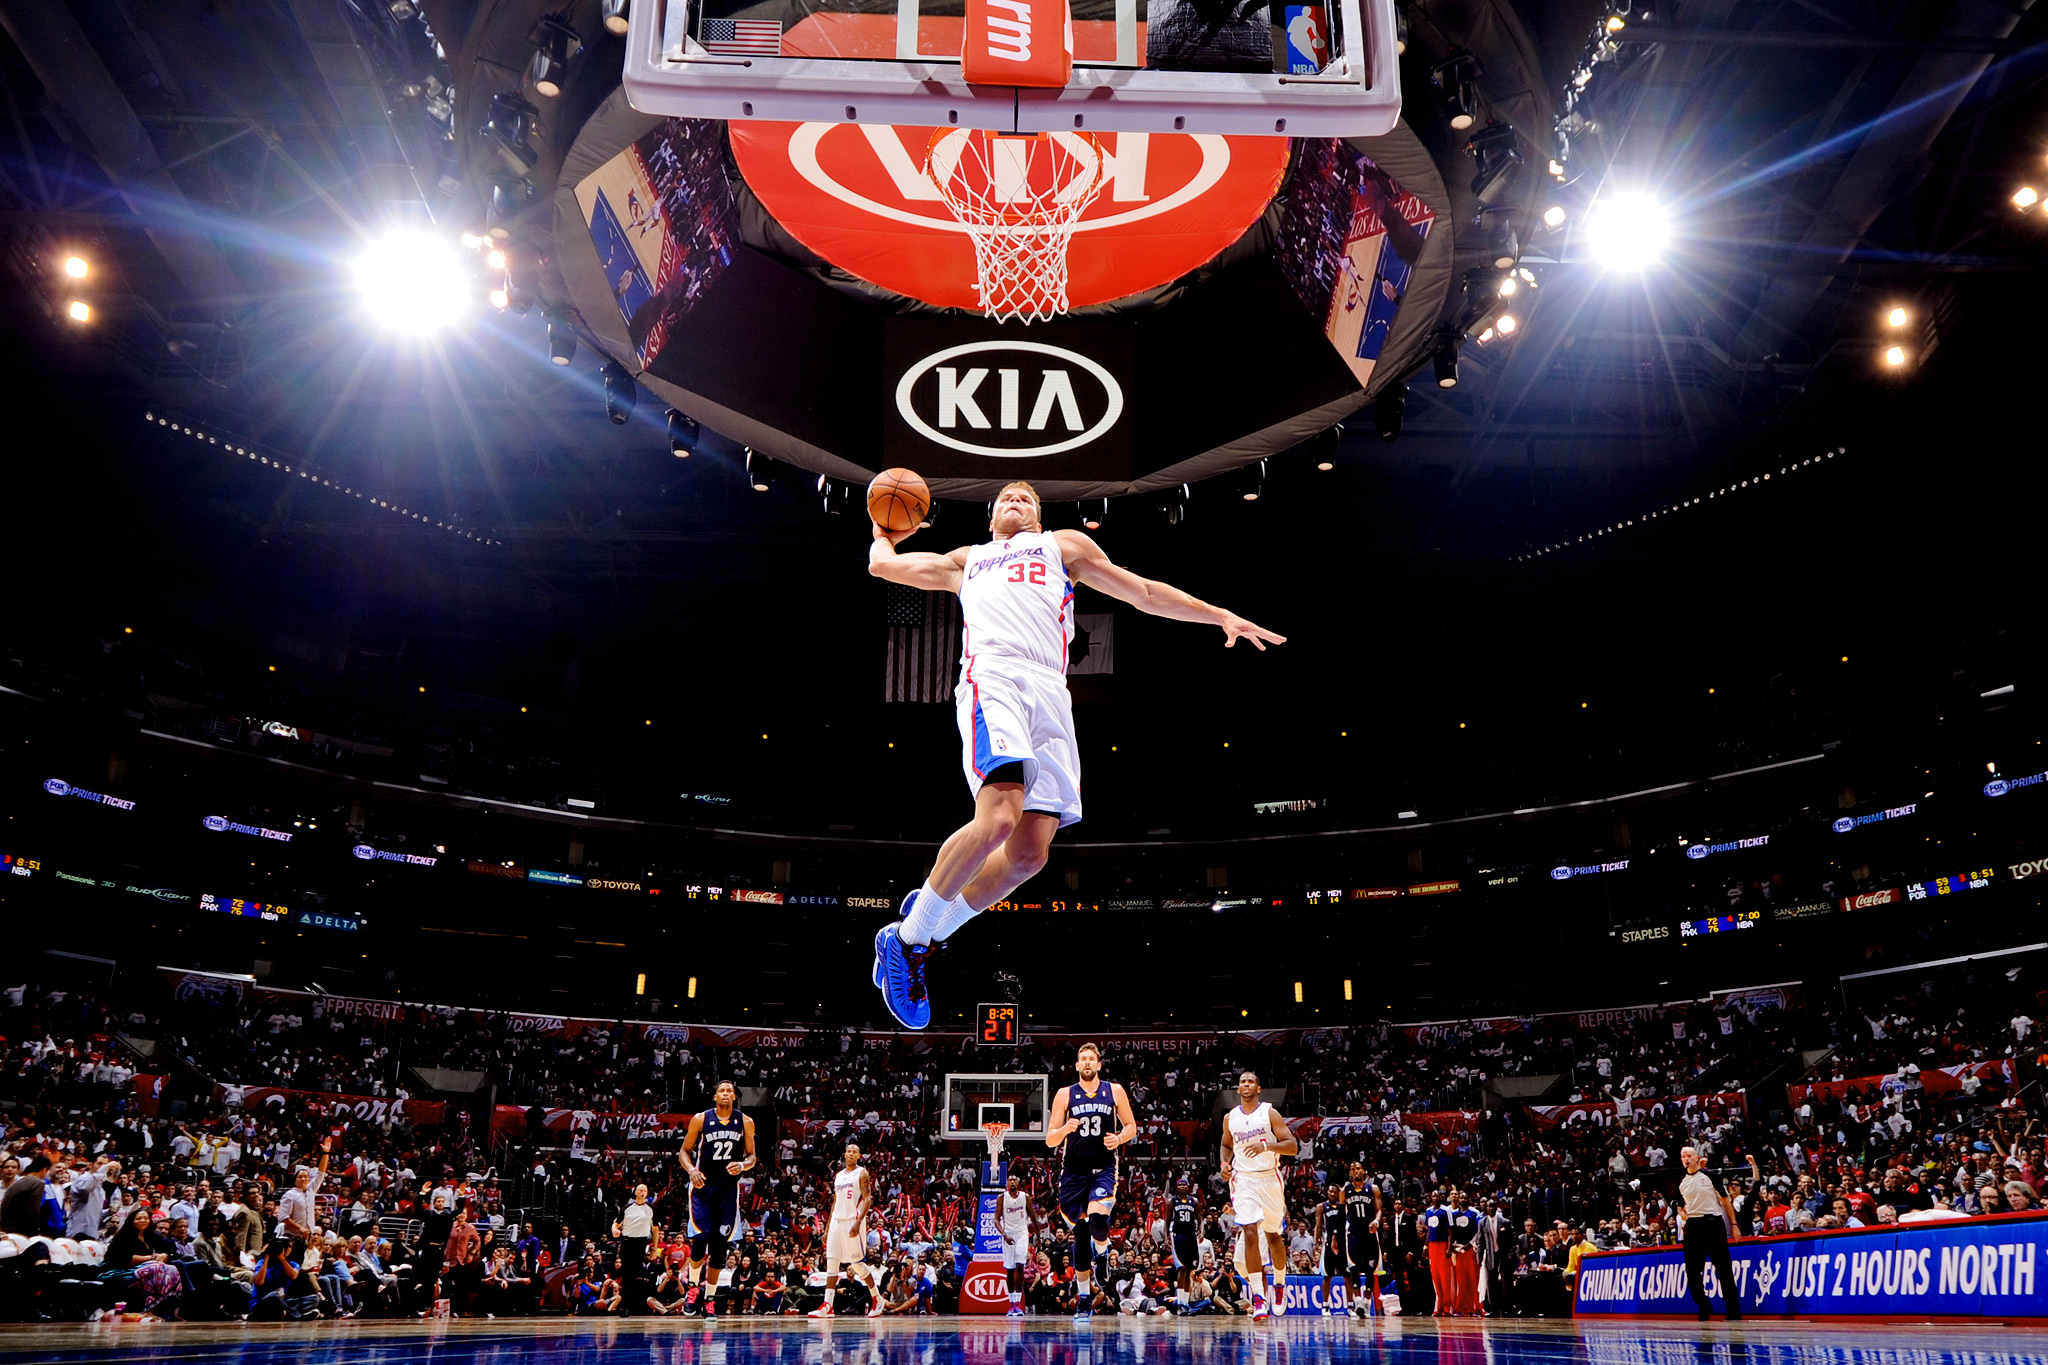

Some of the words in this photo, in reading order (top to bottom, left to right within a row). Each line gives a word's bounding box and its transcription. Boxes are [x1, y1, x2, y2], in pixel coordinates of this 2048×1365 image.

[1292, 64, 1316, 74] NBA
[936, 366, 1086, 431] KIA
[968, 547, 1047, 580] Clippers
[1008, 562, 1046, 586] 32
[2012, 773, 2044, 789] PRIME
[70, 787, 102, 803] PRIME
[102, 794, 136, 811] TICKET
[1856, 812, 1885, 826] PRIME
[1885, 804, 1917, 819] TICKET
[229, 822, 259, 836] PRIME
[259, 827, 293, 842] TICKET
[1710, 842, 1738, 853] PRIME
[1738, 835, 1769, 848] TICKET
[16, 857, 41, 870] 8:51
[377, 850, 406, 862] PRIME
[406, 854, 437, 867] TICKET
[11, 865, 33, 877] NBA
[1574, 864, 1601, 876] PRIME
[1601, 860, 1629, 872] TICKET
[55, 870, 96, 886] Panasonic
[603, 880, 641, 891] TOYOTA
[1488, 876, 1518, 885] verion
[1907, 883, 1925, 893] LAL
[1936, 877, 1949, 887] 59
[1970, 868, 1994, 880] 8:51
[686, 885, 701, 893] LAC
[707, 886, 723, 894] MEM
[1306, 891, 1321, 899] LAC
[1327, 889, 1342, 897] MEM
[1909, 891, 1927, 901] POR
[1937, 886, 1950, 895] 68
[1969, 879, 1989, 889] NBA
[201, 894, 215, 903] GS
[232, 899, 244, 908] 72
[265, 904, 288, 915] 7:00
[800, 896, 838, 905] DELTA
[847, 897, 890, 908] STAPLES
[1052, 901, 1066, 912] 57
[1162, 899, 1210, 909] Budweiser
[1855, 889, 1892, 908] Coca-Cola
[200, 902, 220, 911] PHX
[230, 907, 243, 916] 76
[261, 912, 279, 922] NBA
[1773, 908, 1791, 917] SAN
[1797, 902, 1832, 912] MANUEL
[314, 916, 358, 930] DELTA
[1680, 921, 1691, 930] GS
[1707, 917, 1718, 926] 72
[1738, 911, 1760, 921] 7:00
[1622, 926, 1669, 943] STAPLES
[1681, 928, 1698, 937] PHX
[1708, 925, 1719, 933] 76
[1737, 921, 1754, 930] NBA
[989, 1008, 1014, 1020] 8:29
[984, 1019, 1012, 1042] 21
[756, 1035, 778, 1047] LOS
[1071, 1103, 1113, 1116] MEMPHIS
[1079, 1115, 1102, 1137] 33
[704, 1131, 742, 1142] MEMPHIS
[1233, 1127, 1266, 1145] Clippers
[712, 1141, 733, 1160] 22
[847, 1190, 853, 1199] 5
[1179, 1211, 1191, 1222] 50
[1355, 1204, 1365, 1218] 11
[980, 1227, 1000, 1236] RESO
[1579, 1266, 1637, 1301] CHUMASH
[1639, 1262, 1688, 1300] CASINO
[1782, 1254, 1829, 1298] JUST
[1832, 1252, 1845, 1296] 2
[1850, 1248, 1931, 1297] HOURS
[1938, 1242, 2036, 1296] NORTH
[974, 1279, 1010, 1296] KIA
